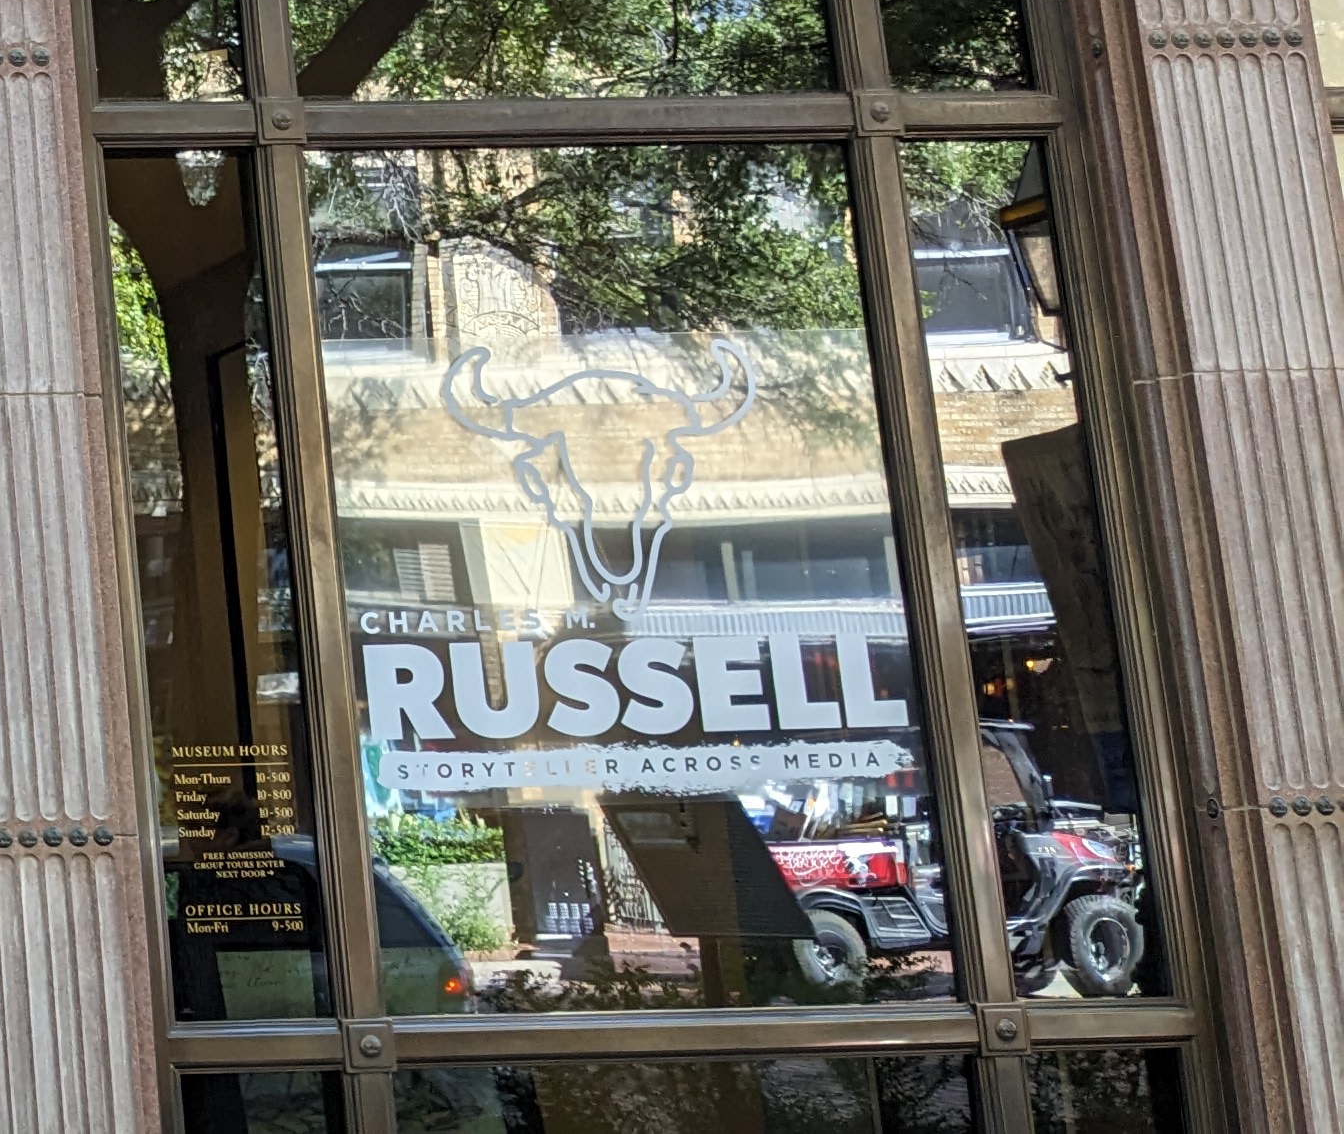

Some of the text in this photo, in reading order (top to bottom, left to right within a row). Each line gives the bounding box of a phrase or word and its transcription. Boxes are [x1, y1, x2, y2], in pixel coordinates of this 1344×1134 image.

[360, 609, 596, 634] CHARLES M.
[362, 633, 909, 740] RUSSELL
[172, 744, 288, 758] MUSEUM HOURS
[642, 754, 761, 774] ACROSS
[784, 751, 880, 770] MEDIA
[174, 773, 231, 785] Mon-Thurs
[175, 790, 208, 804] Friday
[177, 807, 220, 822] Saturday
[178, 825, 216, 840] Sunday
[202, 850, 275, 860] FREE ADMISSION
[193, 859, 286, 870] GROUP TOURS ENTER
[216, 869, 267, 879] NEXT DOOR
[185, 902, 302, 917] OFFICE HOURS
[187, 921, 230, 934] Mon-Fri
